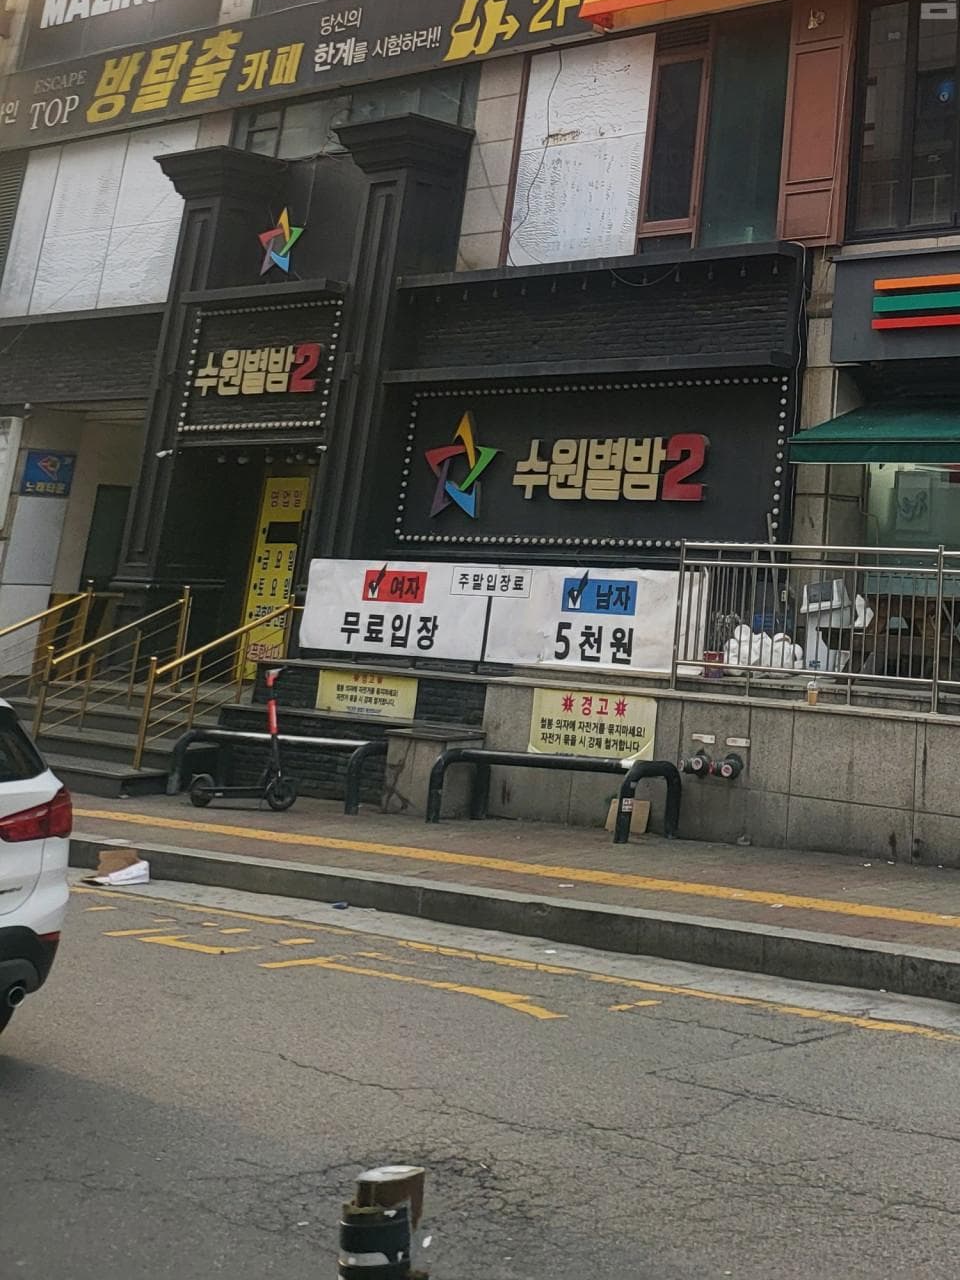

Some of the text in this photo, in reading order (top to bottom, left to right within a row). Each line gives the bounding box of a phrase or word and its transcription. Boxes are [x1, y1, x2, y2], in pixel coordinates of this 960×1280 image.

[320, 7, 362, 36] 당신의
[313, 26, 442, 73] 한계를 시험하라!!
[29, 95, 79, 130] TOP
[86, 28, 243, 124] 방탈출
[238, 42, 304, 91] 카페
[194, 343, 320, 396] 수원별밤2
[513, 433, 709, 501] 수원별밤2
[390, 573, 420, 600] 여자
[458, 572, 525, 593] 주말입장료
[595, 584, 631, 611] 남자
[341, 611, 438, 650] 무료입장
[555, 621, 635, 665] 5천원
[582, 696, 608, 716] 경고
[541, 732, 561, 744] 자전거
[578, 721, 605, 734] 자전거를
